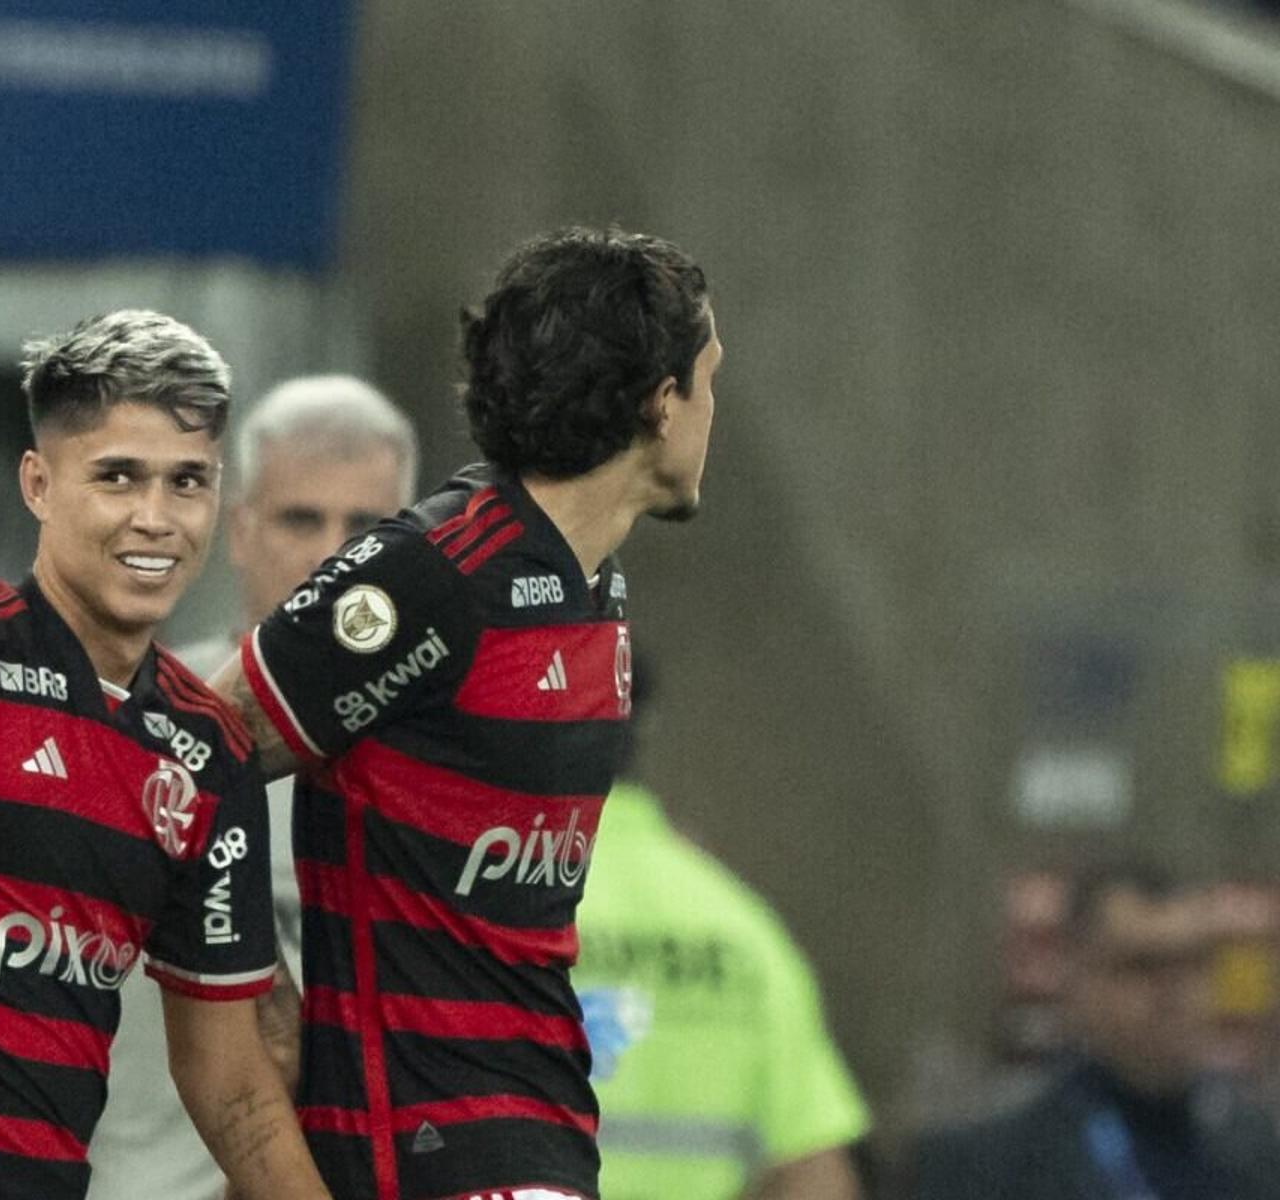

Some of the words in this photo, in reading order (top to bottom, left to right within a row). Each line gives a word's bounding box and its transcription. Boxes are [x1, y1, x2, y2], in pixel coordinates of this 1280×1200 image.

[528, 575, 564, 606] BRB
[24, 665, 69, 702] BRB
[365, 626, 450, 706] kwai
[203, 870, 241, 945] wai
